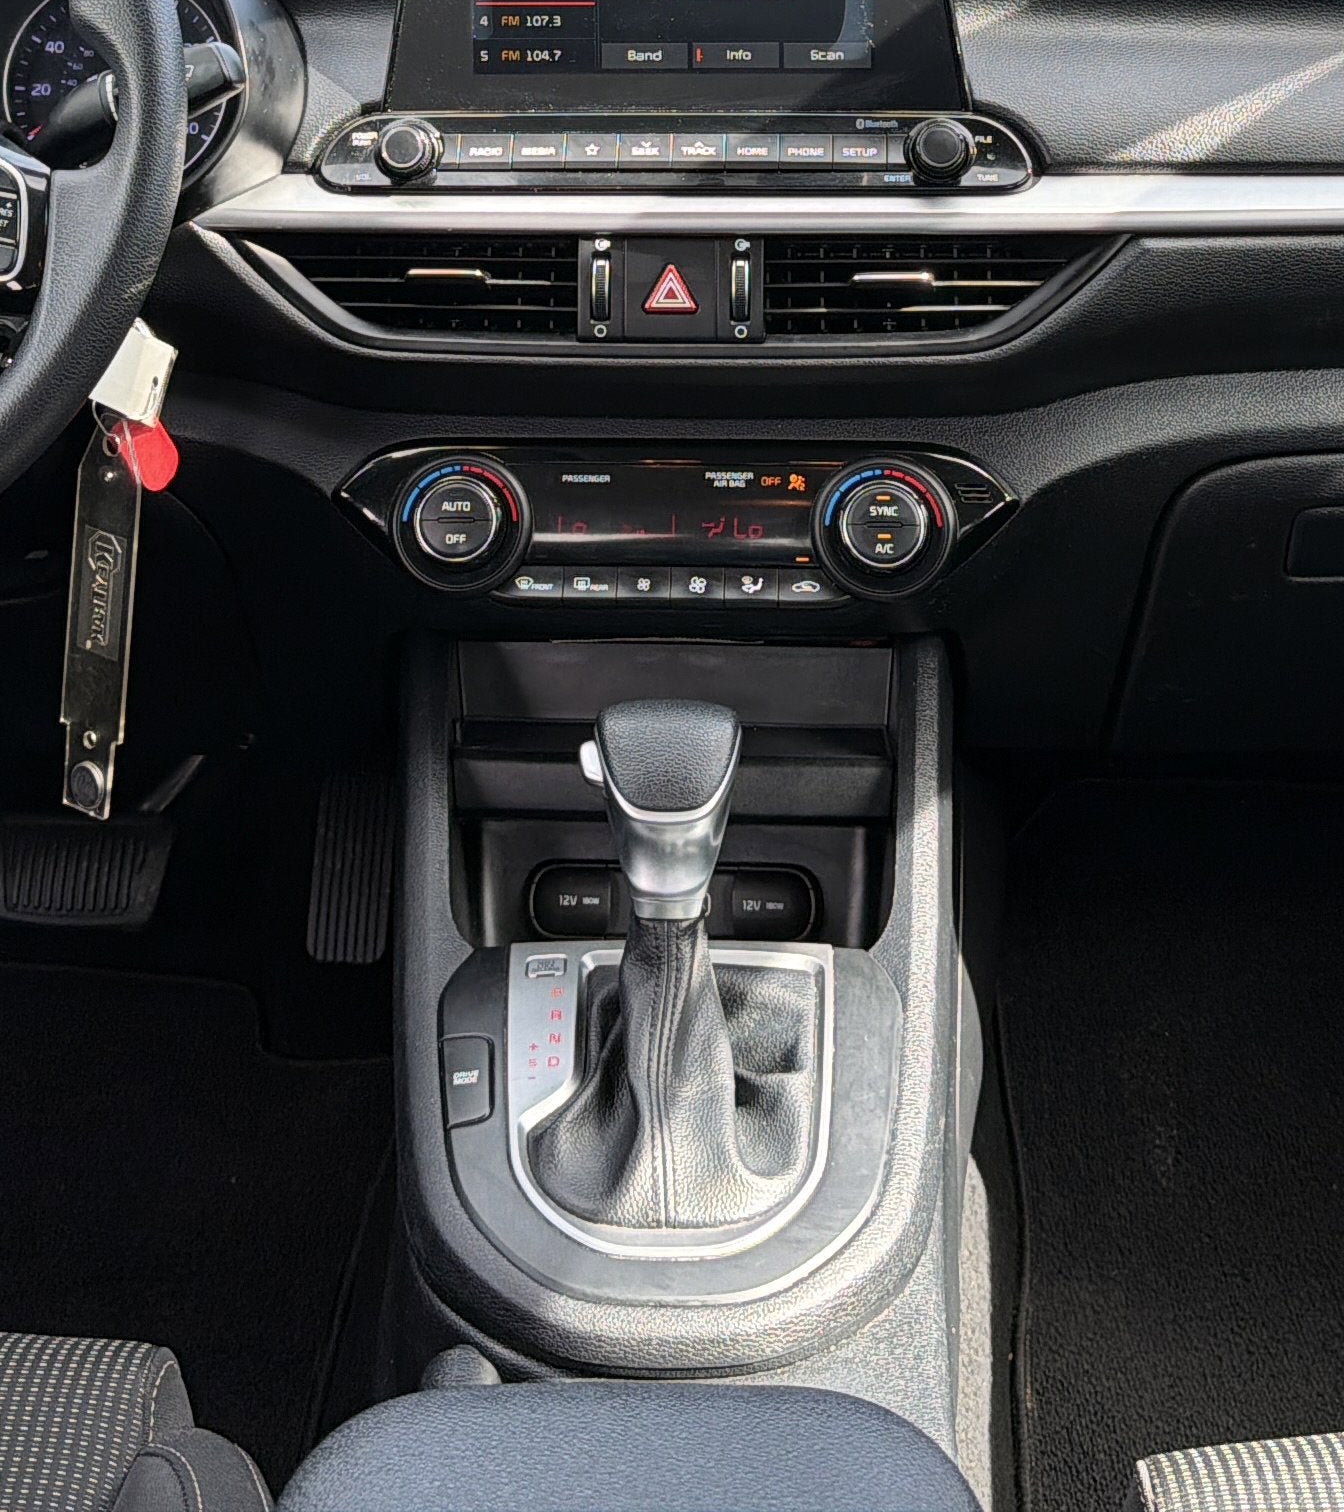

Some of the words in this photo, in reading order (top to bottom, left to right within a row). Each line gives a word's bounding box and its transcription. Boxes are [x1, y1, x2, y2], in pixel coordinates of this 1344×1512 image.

[480, 15, 488, 27] 4
[501, 15, 520, 27] FM
[525, 15, 561, 28] 107.3
[44, 41, 65, 54] 40
[480, 50, 489, 62] 5
[501, 50, 520, 62] FM
[525, 50, 562, 62] 104.7
[627, 49, 662, 62] Band
[726, 49, 751, 61] Info
[809, 49, 844, 62] Scan
[31, 83, 52, 96] 20
[681, 147, 716, 157] TRACK
[736, 146, 769, 157] HOME
[787, 146, 825, 157] PHONE
[842, 147, 878, 158] SETUP
[705, 472, 754, 480] PASSENGER
[760, 477, 781, 485] OFF
[442, 501, 470, 511] AUTO
[869, 506, 899, 517] SYNC
[445, 534, 466, 543] OFF
[875, 543, 894, 554] A/C
[559, 894, 577, 906] 12V
[742, 899, 761, 911] 12V
